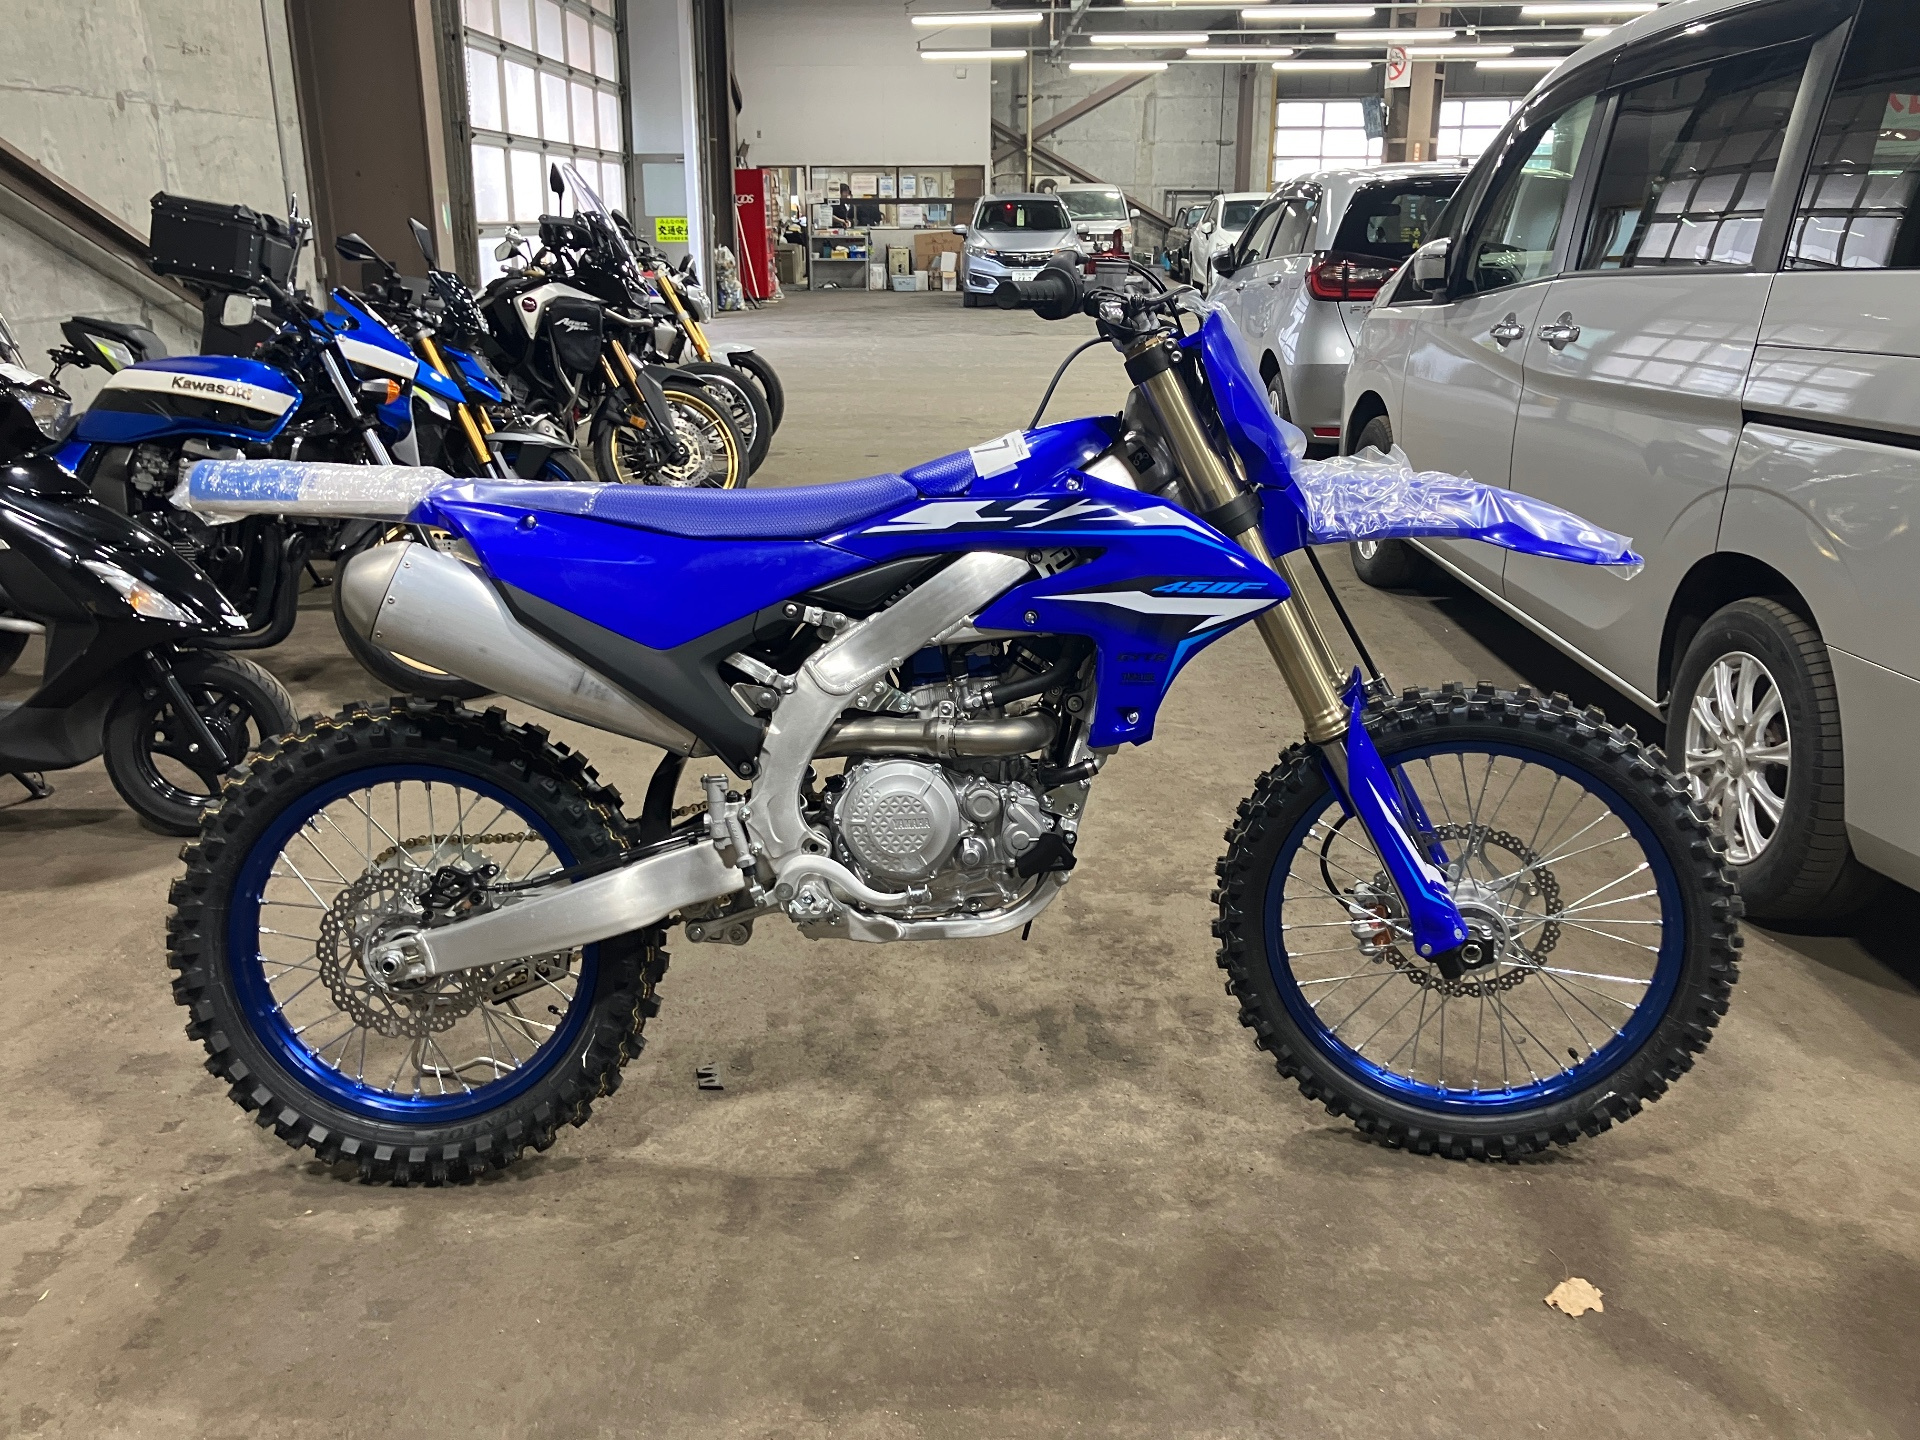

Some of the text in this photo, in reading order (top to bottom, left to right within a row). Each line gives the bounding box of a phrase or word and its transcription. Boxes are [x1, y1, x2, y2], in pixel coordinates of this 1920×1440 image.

[171, 376, 253, 401] Kawasaki
[1151, 581, 1269, 594] 450F
[891, 817, 931, 830] YAMAHA
